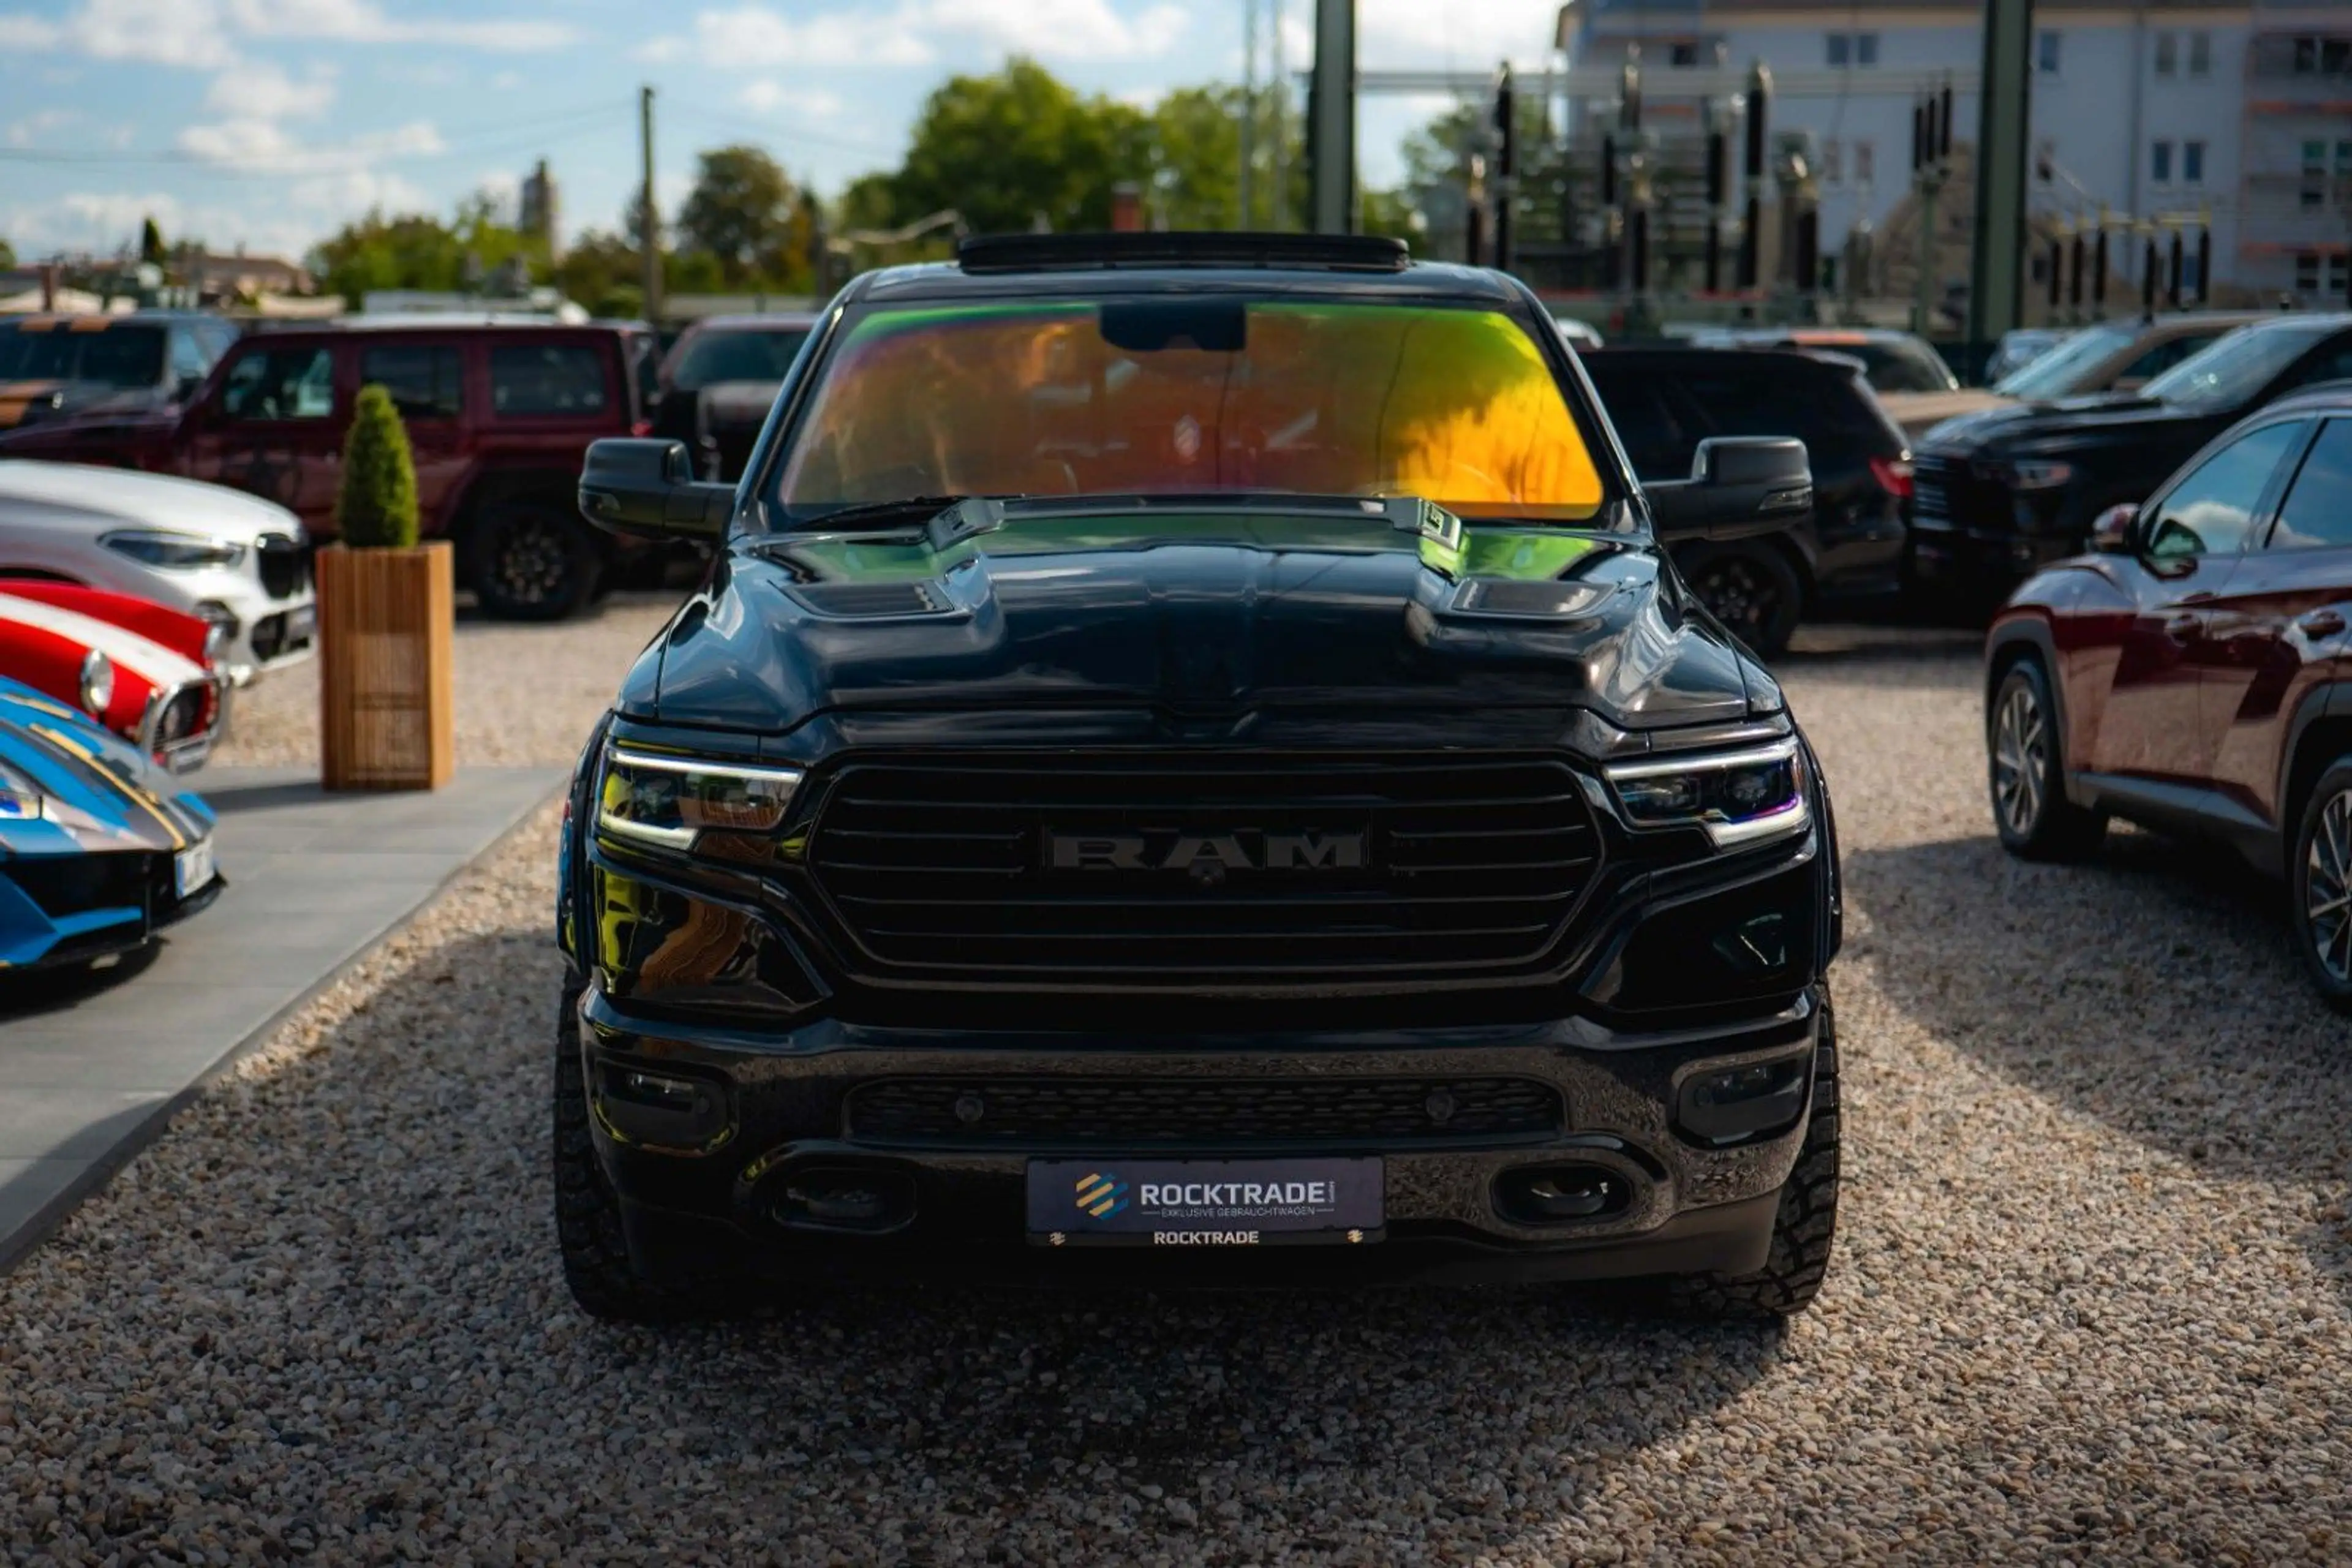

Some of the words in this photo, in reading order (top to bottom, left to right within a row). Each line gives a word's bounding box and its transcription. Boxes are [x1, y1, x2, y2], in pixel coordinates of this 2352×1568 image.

[1054, 835, 1363, 867] RAM
[1140, 1182, 1325, 1205] ROCKTRADE
[1161, 1208, 1215, 1218] EXKLUSIVE
[1217, 1206, 1316, 1217] GEBRAUCHTWAGEN
[1153, 1231, 1259, 1245] ROCKTRADE
